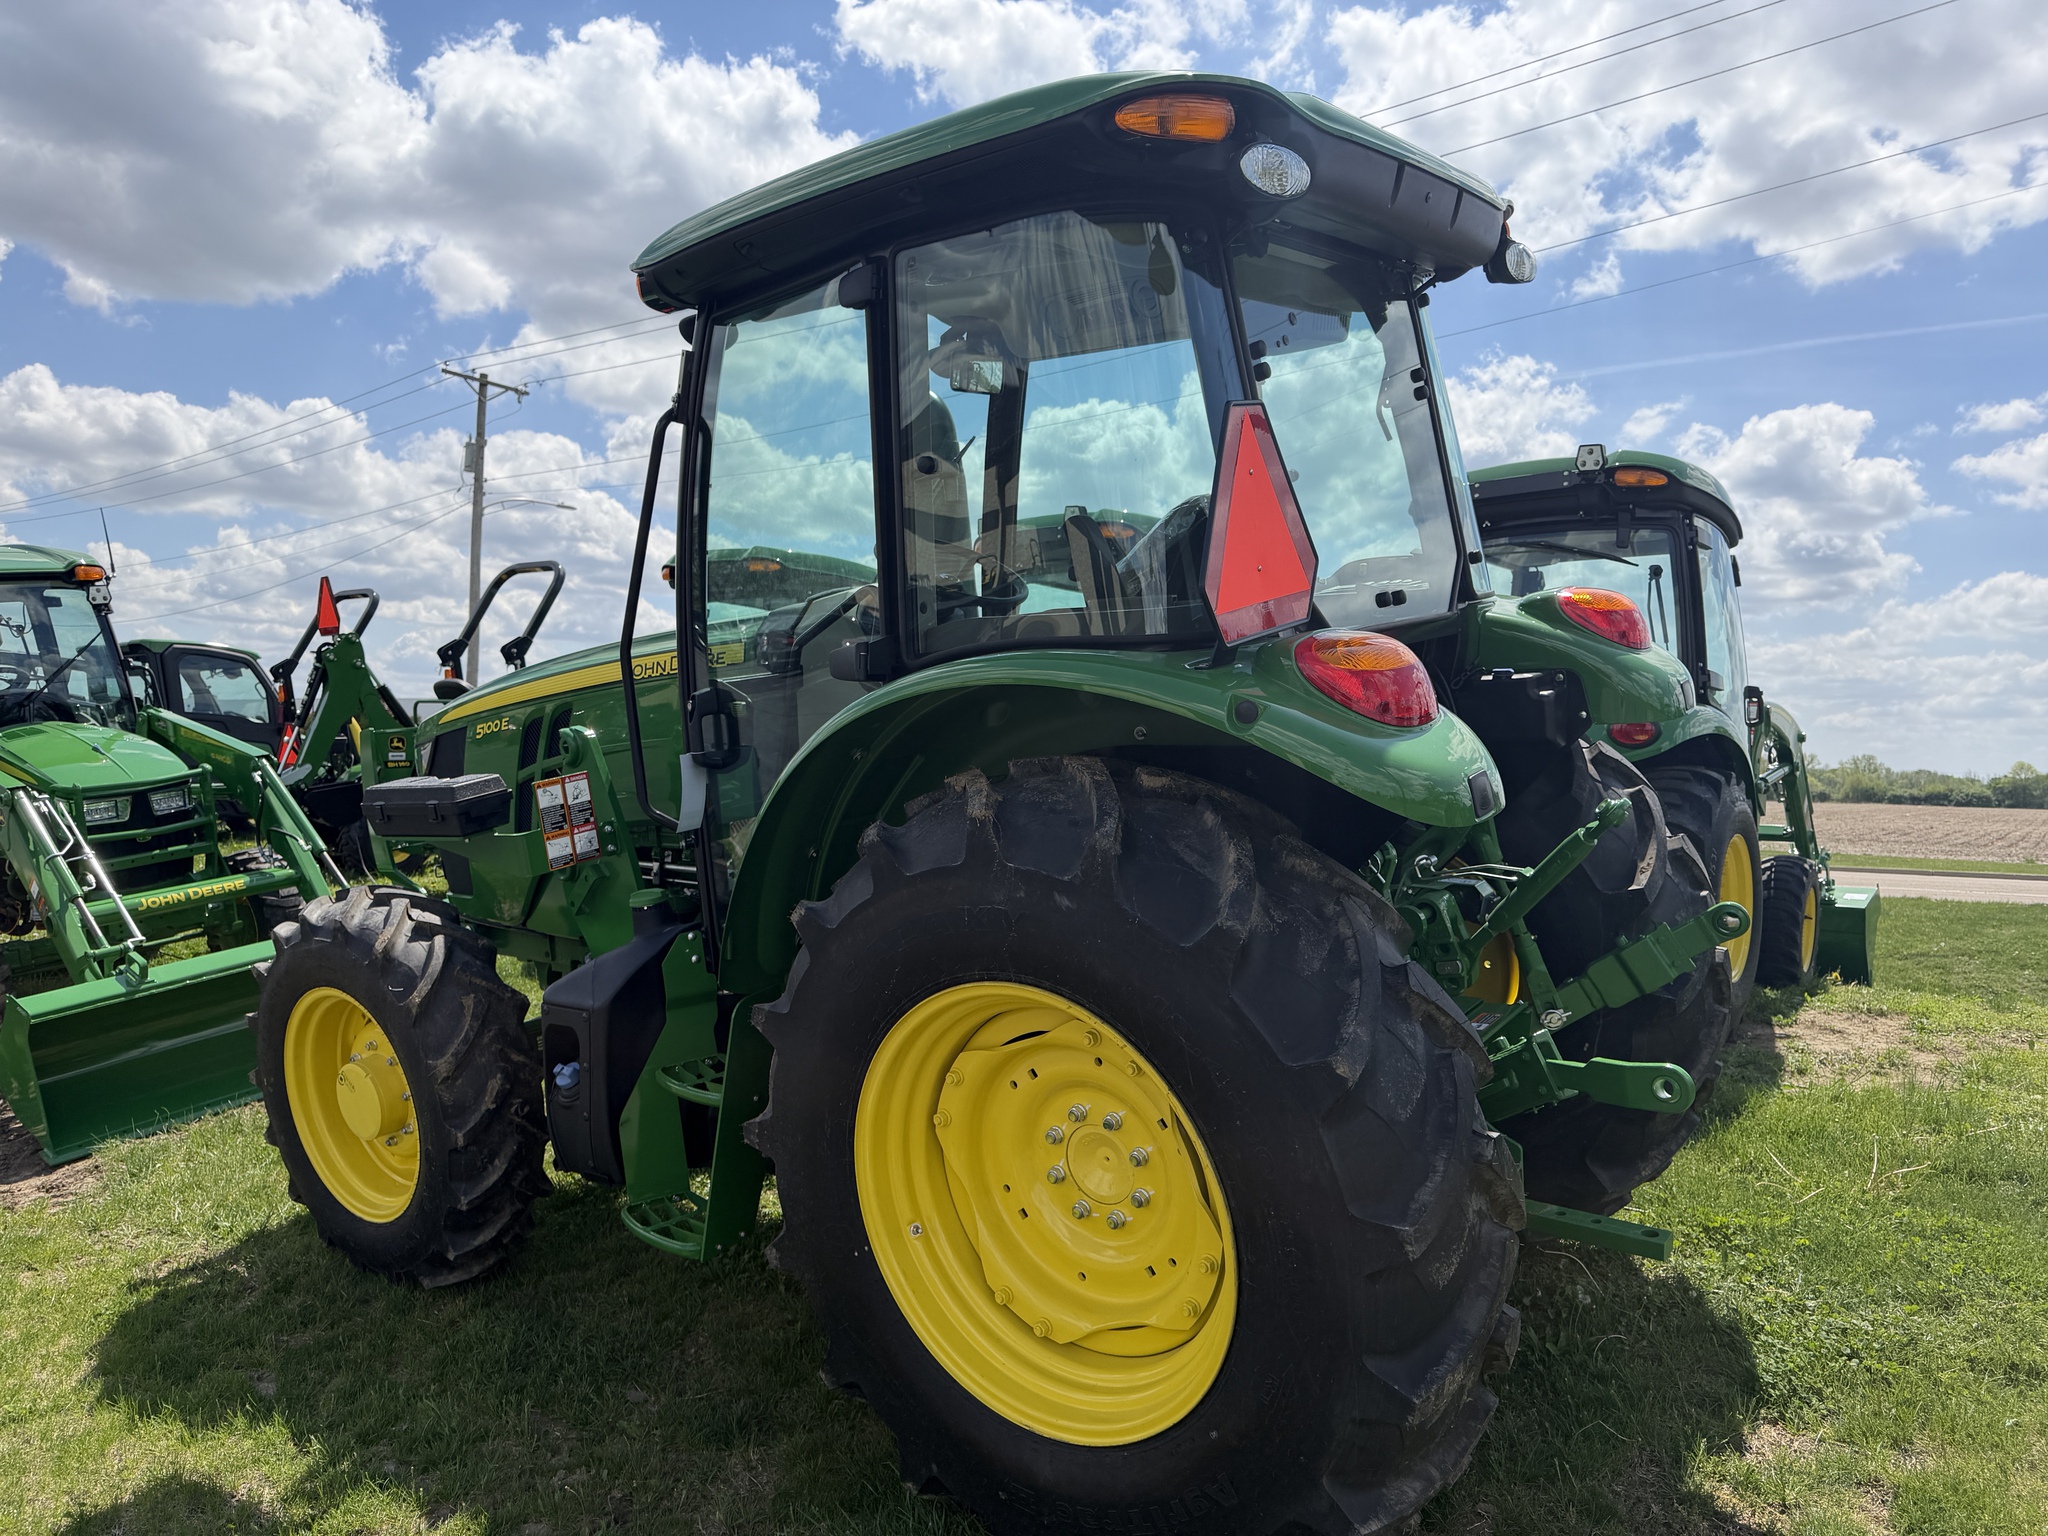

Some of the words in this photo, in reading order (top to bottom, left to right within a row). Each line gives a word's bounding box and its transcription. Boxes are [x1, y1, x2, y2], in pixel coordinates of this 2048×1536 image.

[632, 659, 667, 677] OHN
[137, 891, 186, 911] JOHN
[187, 879, 247, 900] DEERE
